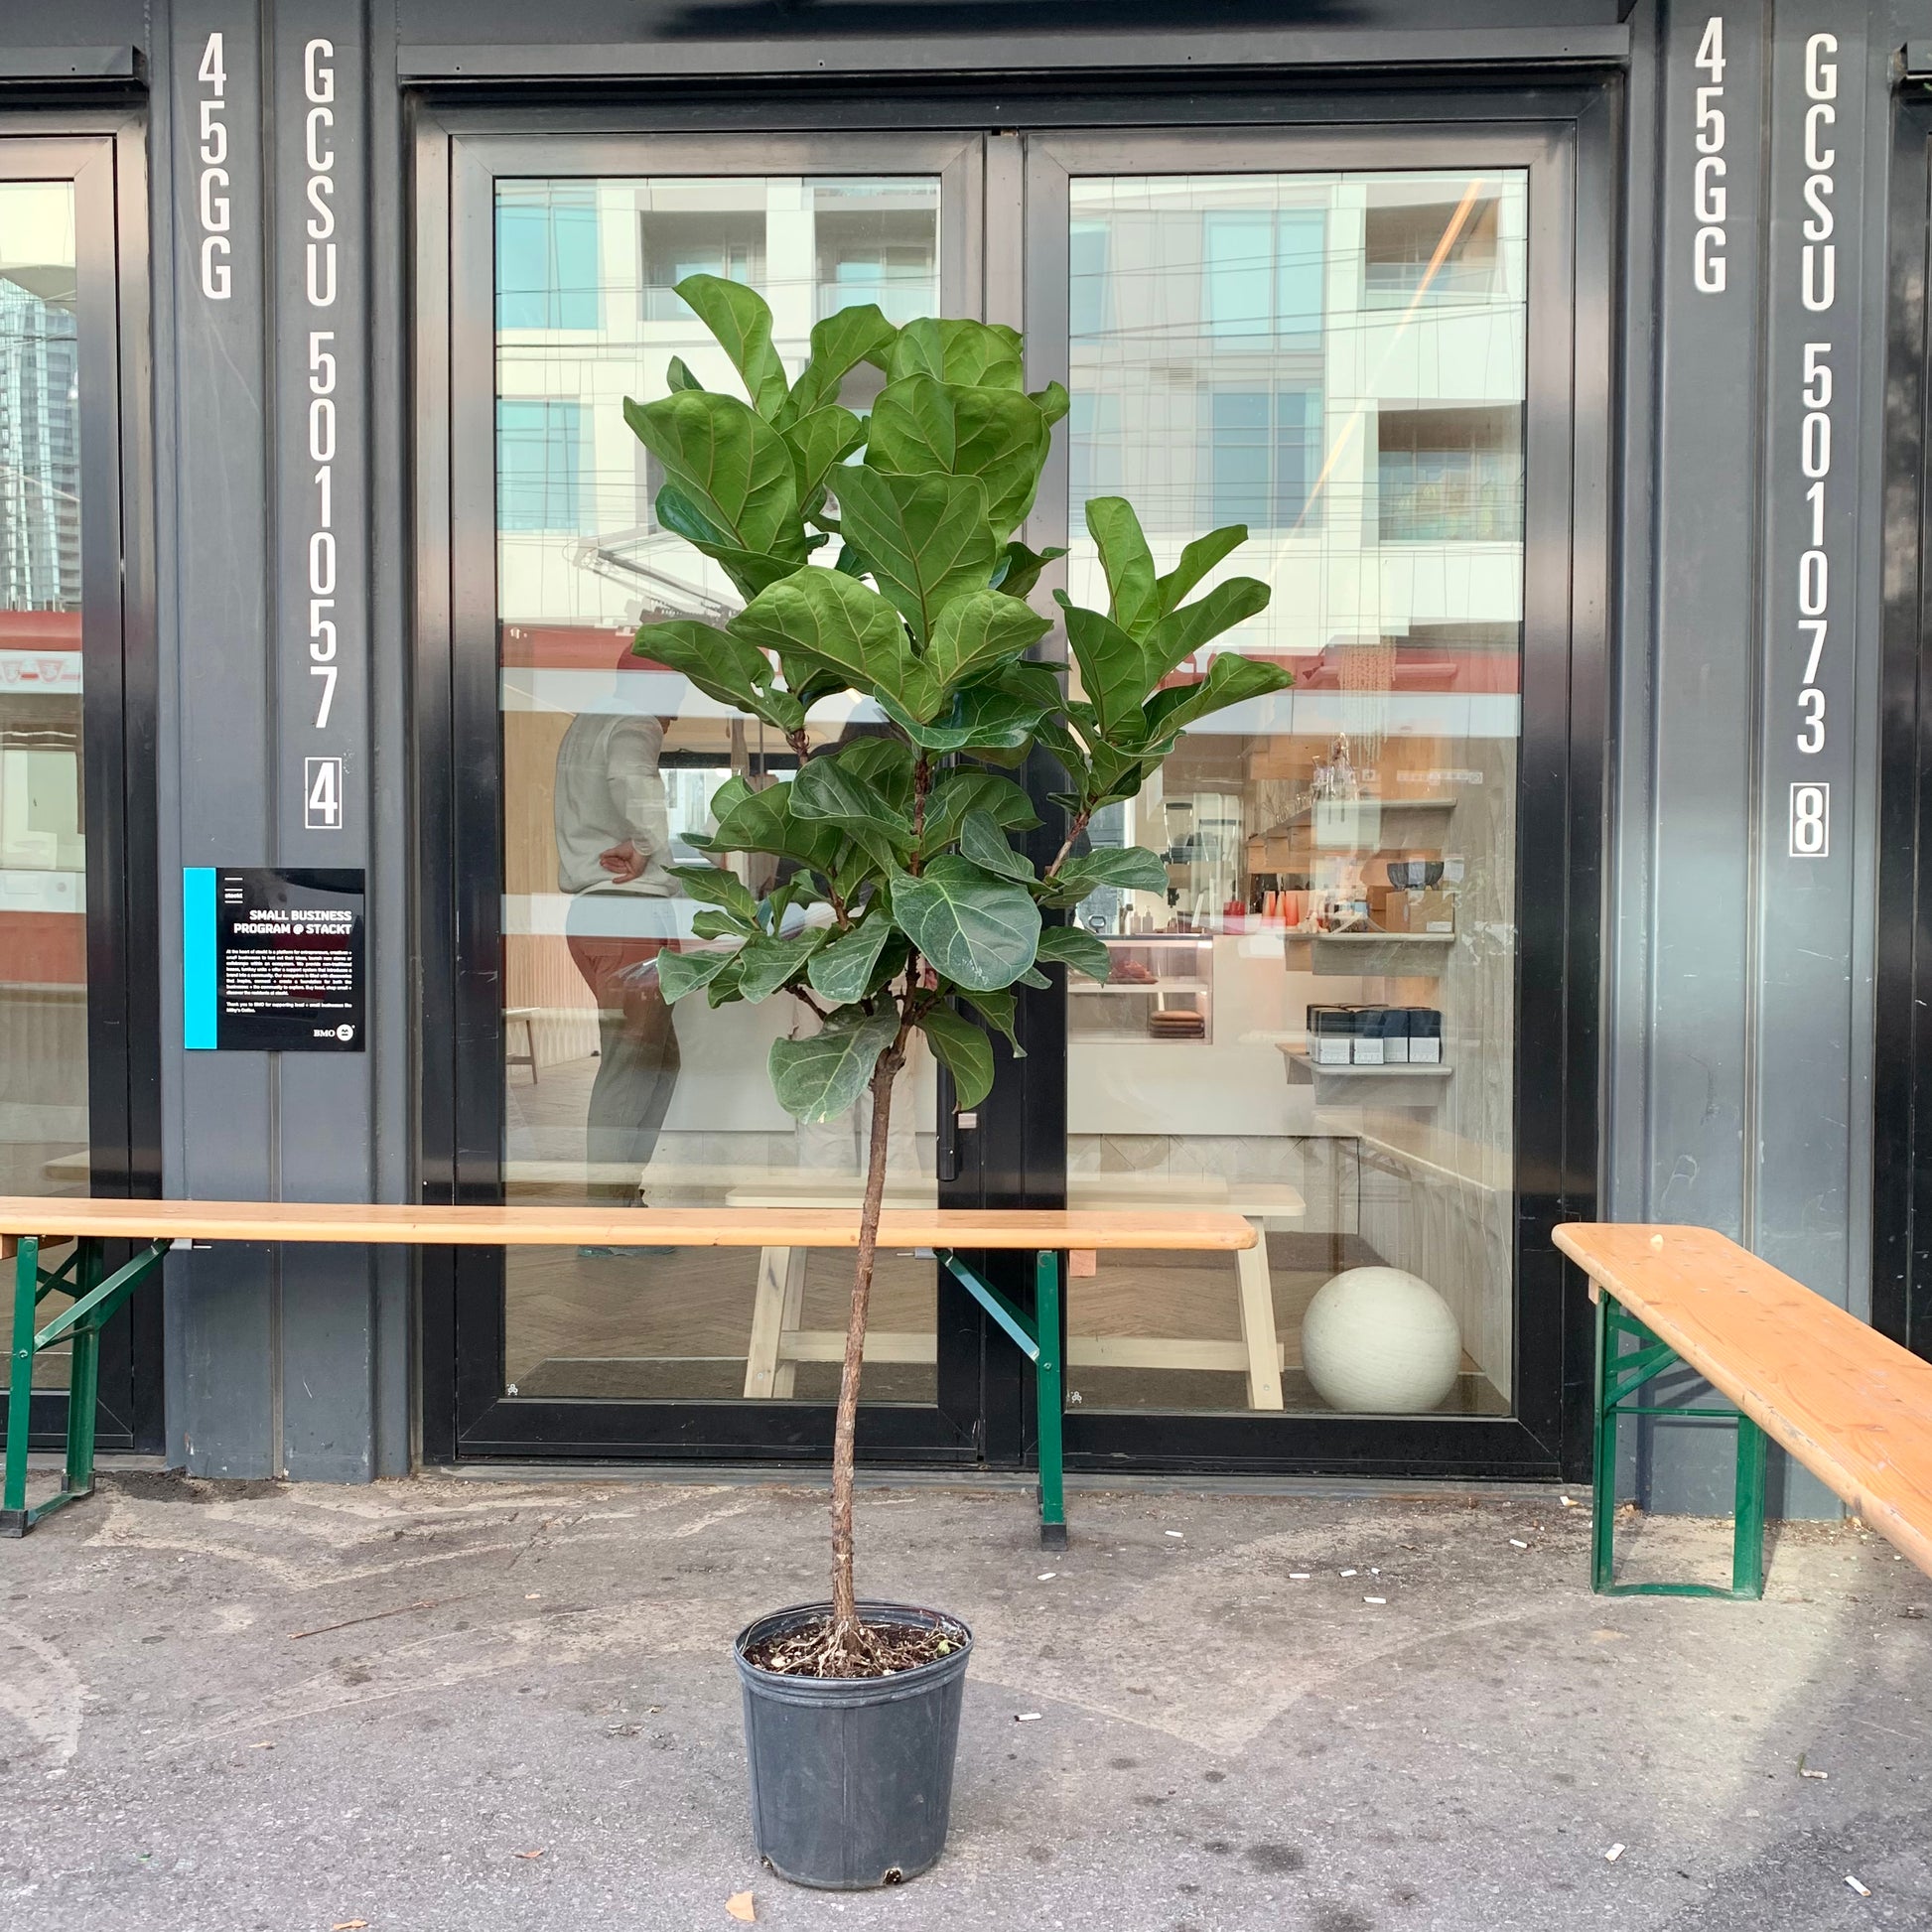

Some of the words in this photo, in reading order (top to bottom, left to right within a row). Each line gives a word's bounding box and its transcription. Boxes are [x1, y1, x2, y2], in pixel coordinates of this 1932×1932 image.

[198, 32, 231, 300] 45GG
[304, 39, 337, 307] GCSU
[1694, 17, 1726, 293] 45GG
[1802, 33, 1838, 312] GCSU
[308, 331, 339, 729] 501057
[1797, 343, 1833, 754] 501073
[249, 909, 289, 920] SMALL
[291, 910, 352, 921] BUSINESS
[309, 761, 339, 825] 4
[1794, 787, 1825, 853] 8
[233, 922, 291, 934] PROGRAM
[293, 924, 304, 934] @
[306, 923, 352, 934] STACKT
[313, 1029, 336, 1037] BMO
